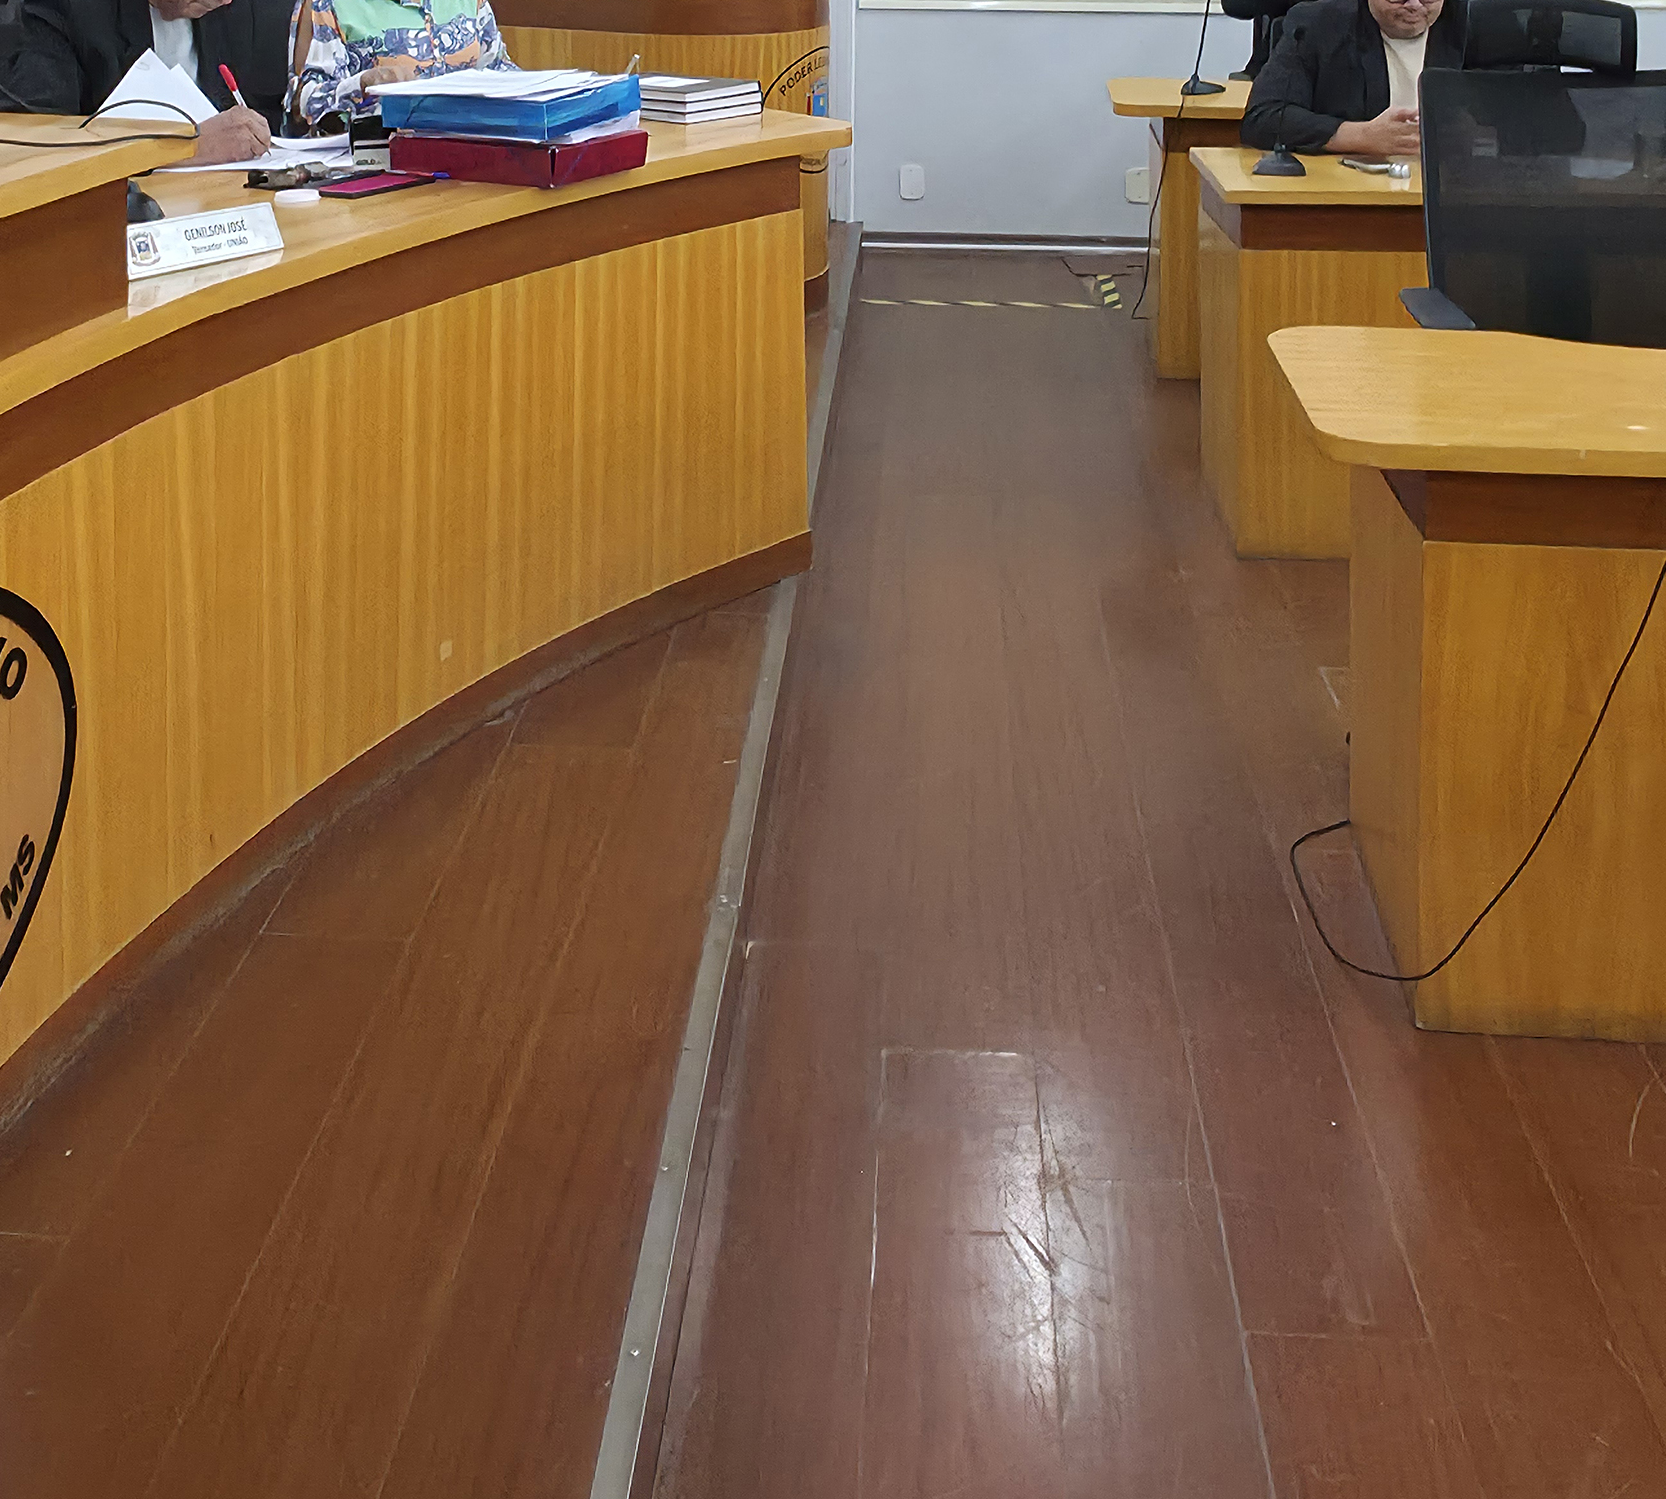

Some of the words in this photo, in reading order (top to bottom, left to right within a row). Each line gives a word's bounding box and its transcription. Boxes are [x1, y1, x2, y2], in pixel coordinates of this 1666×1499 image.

[779, 61, 814, 97] PODER
[227, 216, 248, 237] JOSÉ
[0, 833, 35, 920] MS
